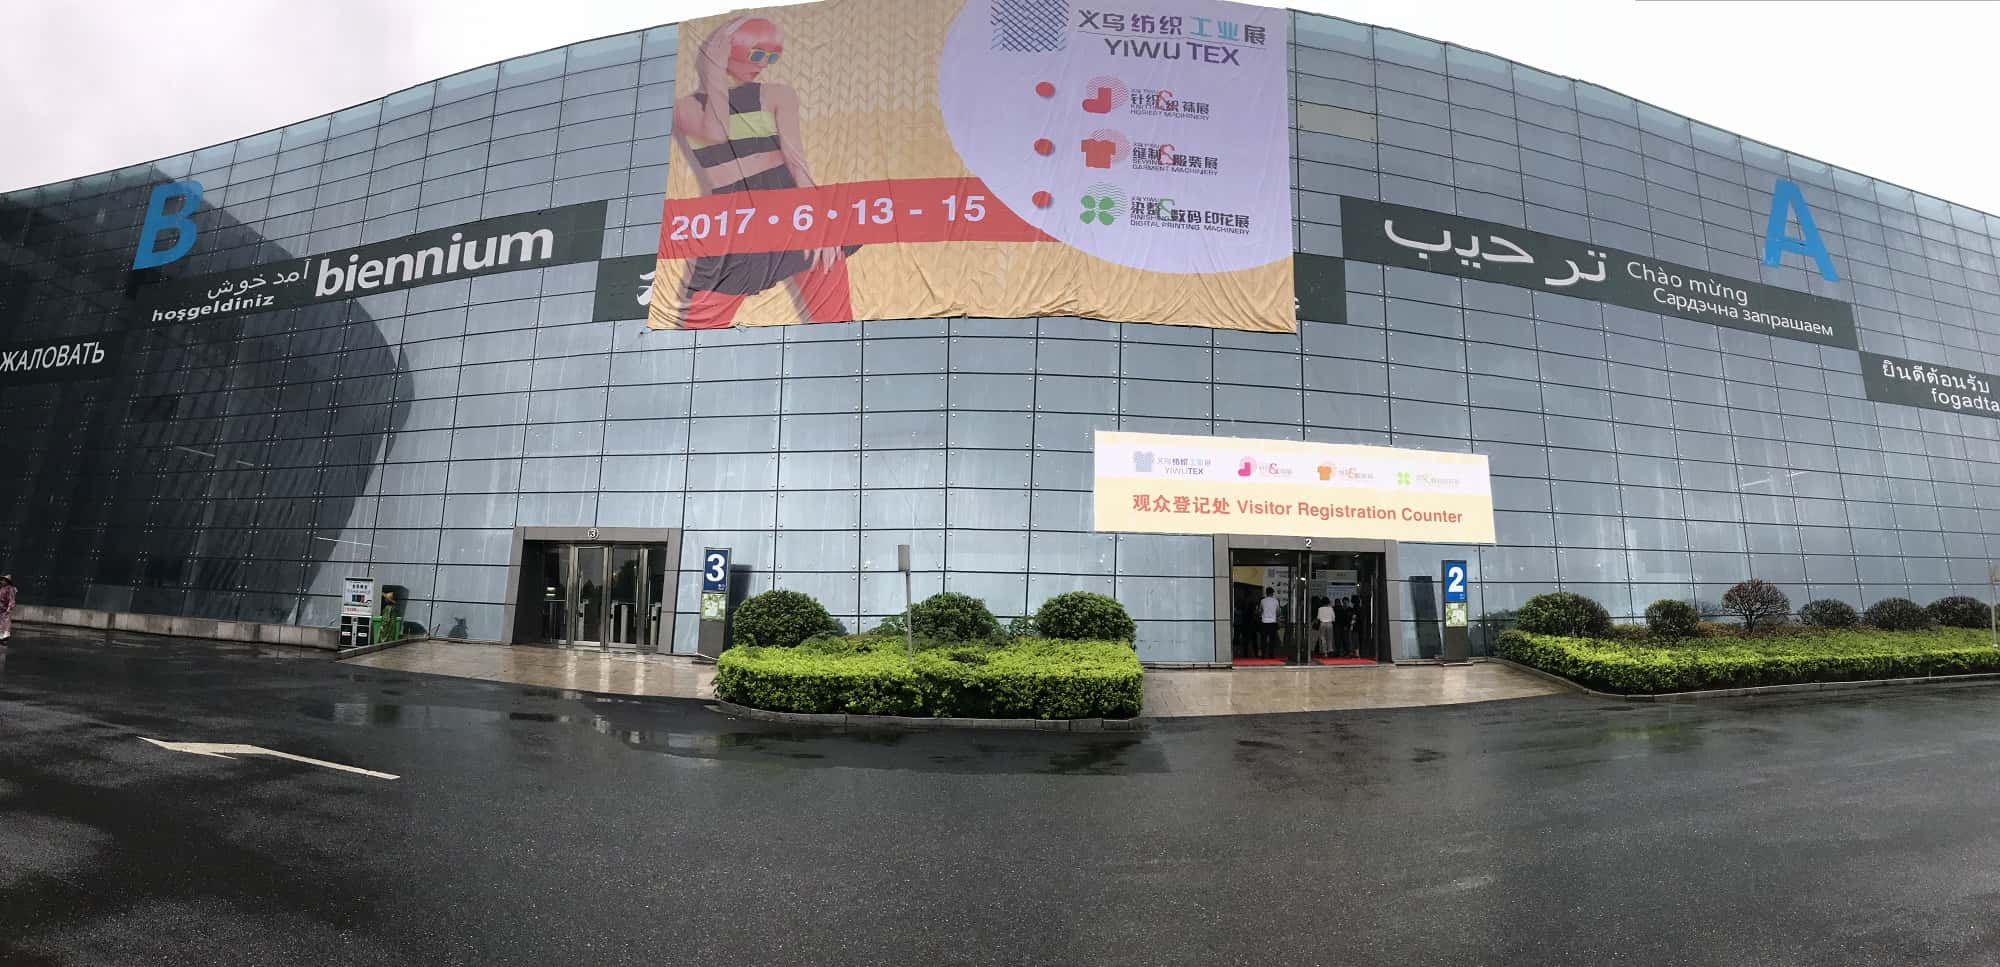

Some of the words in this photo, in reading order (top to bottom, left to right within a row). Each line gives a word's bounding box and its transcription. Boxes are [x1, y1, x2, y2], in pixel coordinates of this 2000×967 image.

[1078, 9, 1266, 46] 义乌纺织工业展
[1104, 38, 1180, 60] YIWU
[1186, 41, 1240, 66] TEX
[133, 180, 204, 271] B
[670, 206, 757, 241] 2017
[792, 204, 814, 231] 6
[851, 197, 894, 226] 13
[942, 194, 987, 222] 15
[1130, 219, 1160, 228] DIGITAL
[1161, 221, 1200, 231] PRINTING
[1203, 224, 1250, 236] MACHINERY
[1761, 178, 1841, 283] A
[315, 228, 553, 297] biennium
[1627, 261, 1682, 288] Chào
[1689, 278, 1748, 306] mừng
[152, 293, 274, 323] hoşgeldiniz
[1653, 287, 1739, 319] Сардэчна
[1743, 309, 1834, 337] запрашаем
[0, 341, 105, 372] ЖАЛОВАТЬ
[1132, 494, 1230, 515] 观众登记处
[1237, 499, 1292, 517] Visitor
[1298, 502, 1397, 522] Registration
[1401, 507, 1463, 525] Counter
[1305, 538, 1312, 548] 2
[706, 553, 726, 582] 3
[1448, 566, 1464, 593] 2
